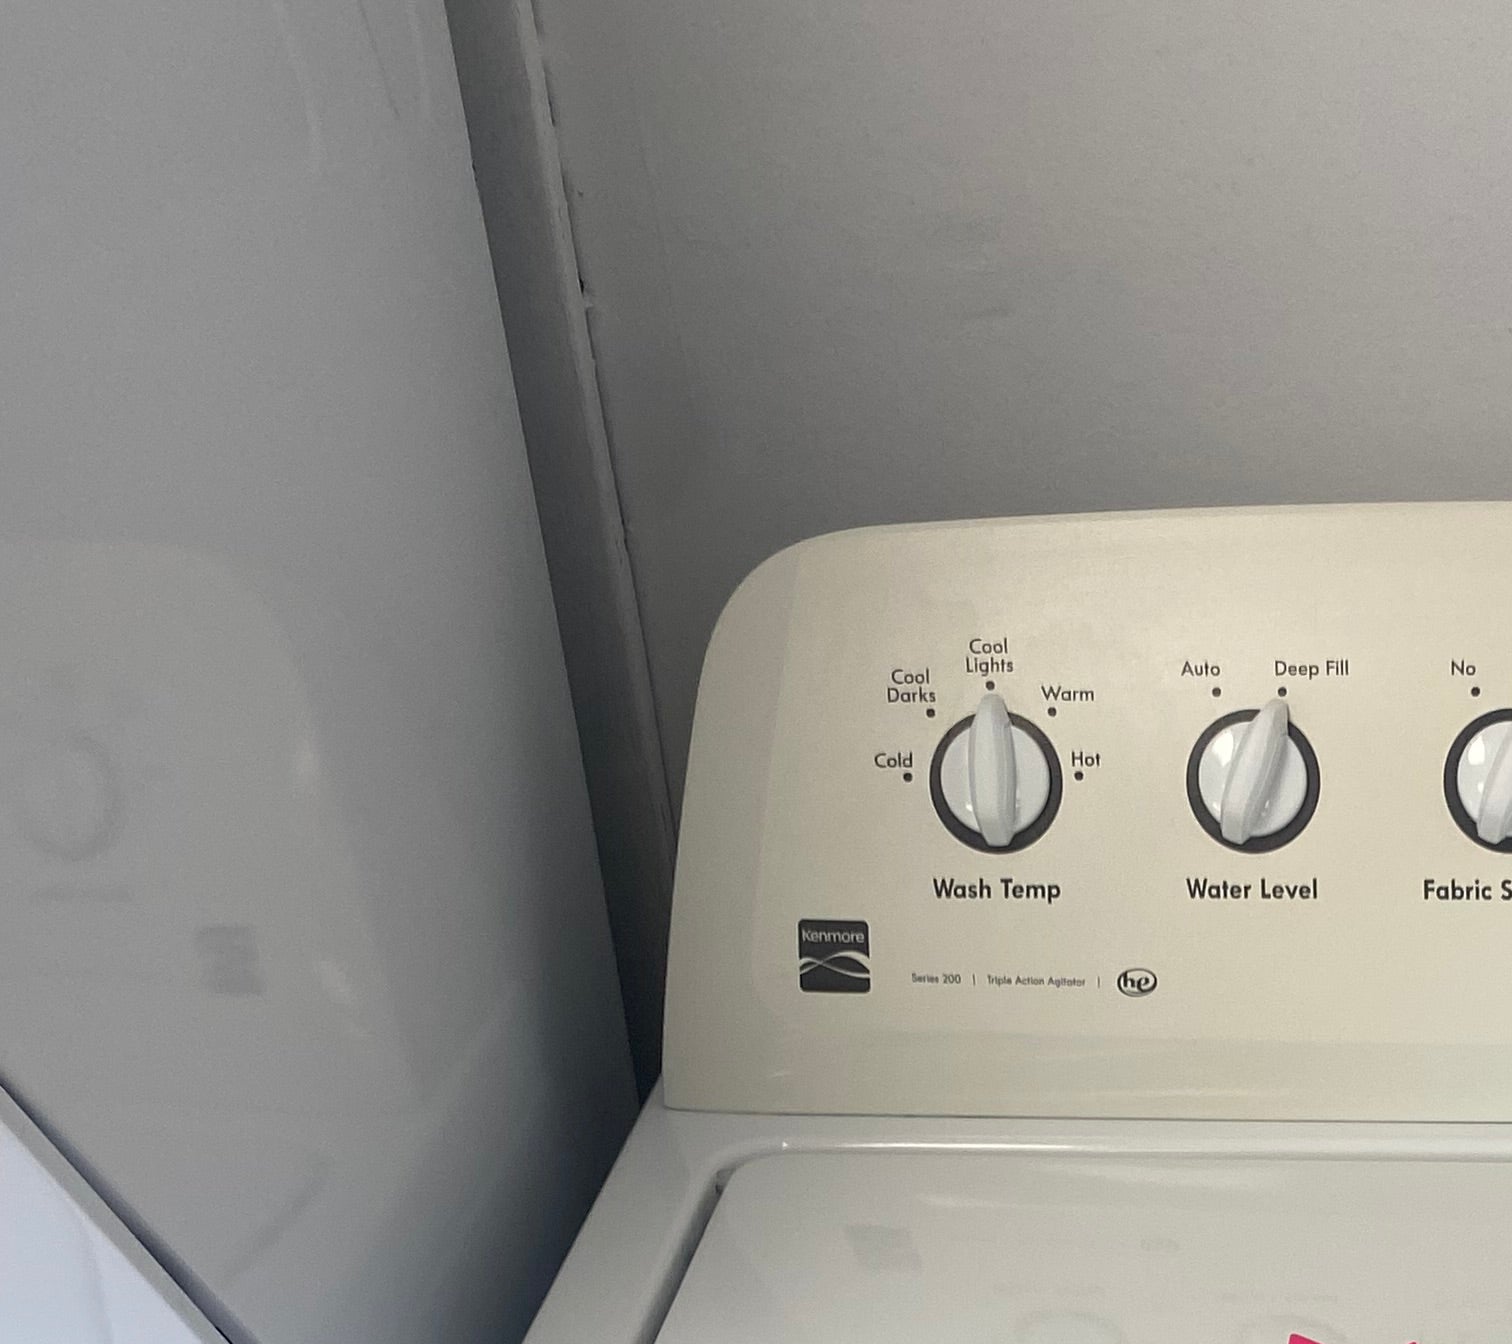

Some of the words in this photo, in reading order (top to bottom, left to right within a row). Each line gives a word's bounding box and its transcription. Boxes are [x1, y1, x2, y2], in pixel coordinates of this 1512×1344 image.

[968, 636, 1009, 655] Cool
[965, 655, 1014, 677] Lights
[1180, 660, 1221, 678] Auto
[1274, 659, 1320, 681] Deep
[1325, 658, 1349, 677] Fill
[1450, 659, 1477, 676] No
[891, 667, 930, 685] Cool
[887, 685, 937, 704] Darks
[1040, 685, 1095, 702] Warm
[873, 751, 913, 769] Cold
[1071, 750, 1101, 768] Hot
[932, 877, 992, 899] Wash
[999, 877, 1061, 905] Temp
[1185, 877, 1252, 900] Water
[1260, 877, 1318, 900] Level
[1423, 878, 1493, 901] Fabric
[801, 928, 865, 944] Kenmore
[911, 972, 940, 984] Series
[942, 972, 962, 985] 200
[986, 973, 1013, 988] Triple
[1014, 975, 1045, 986] Action
[1047, 975, 1086, 989] Agitator
